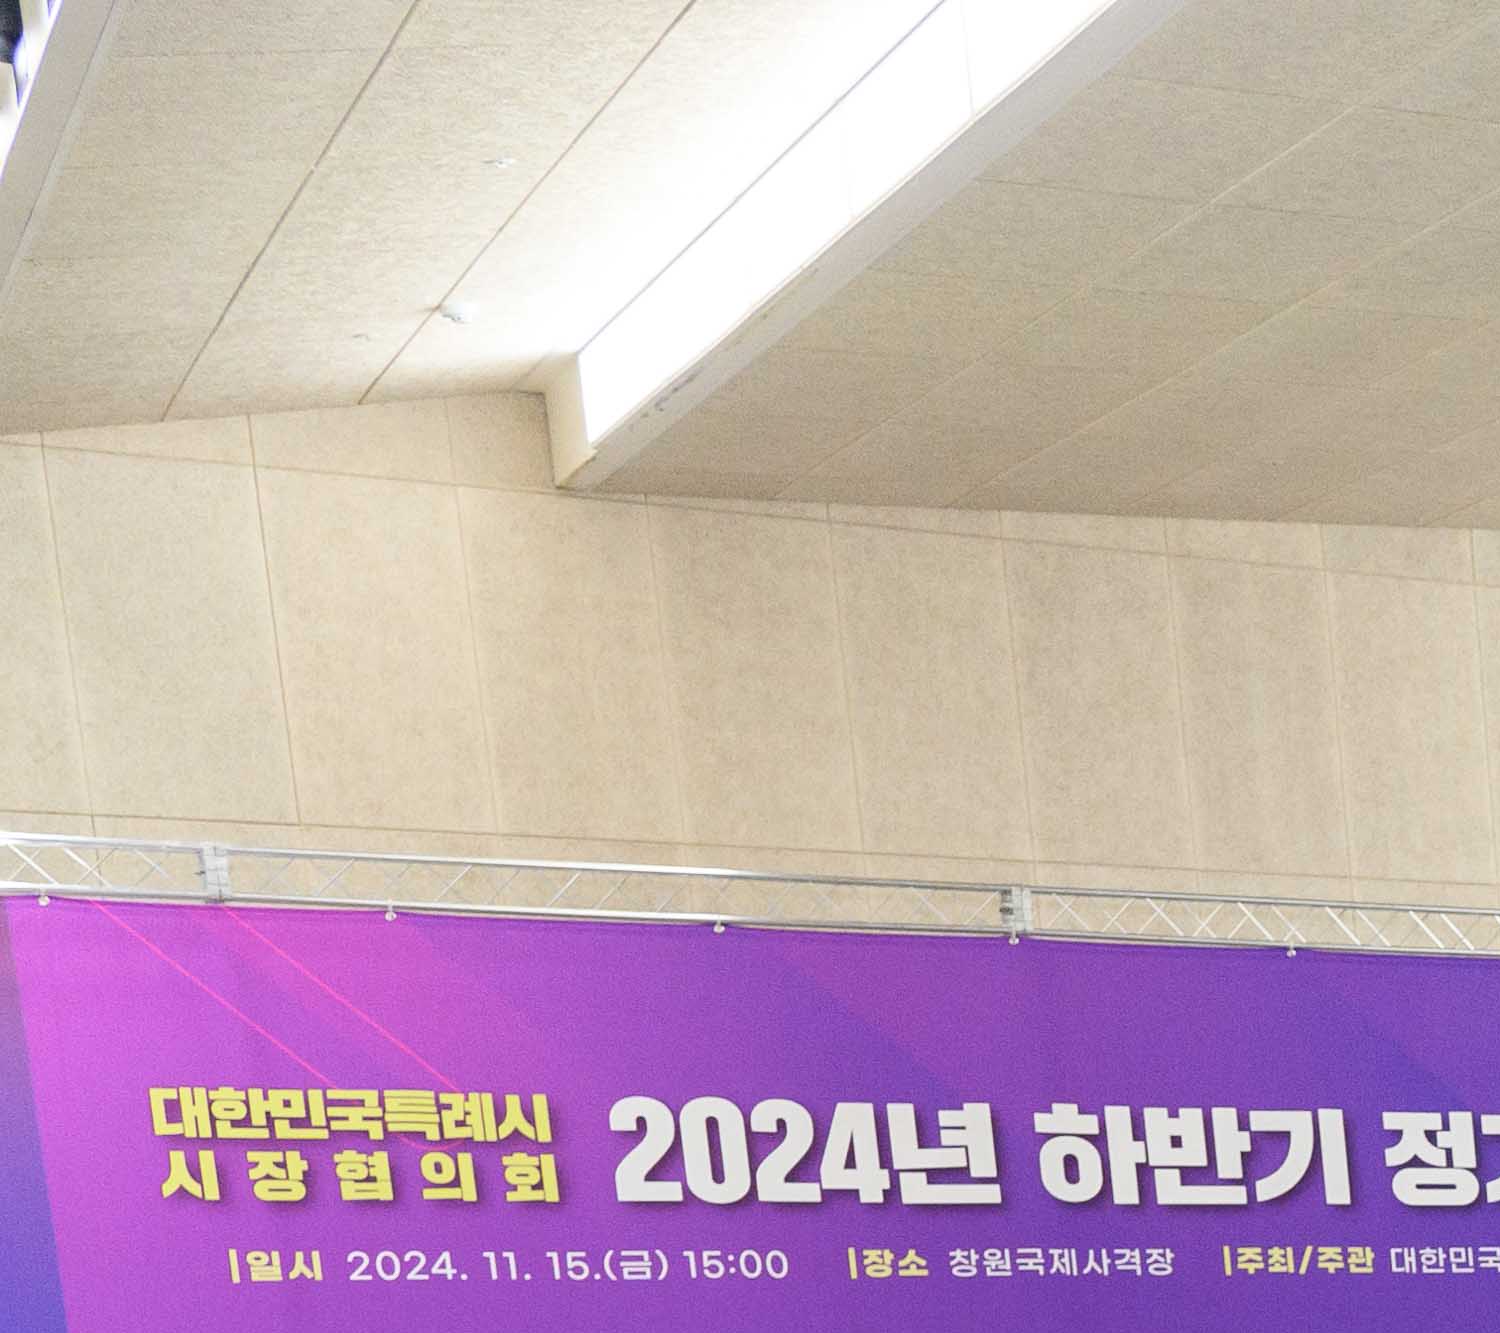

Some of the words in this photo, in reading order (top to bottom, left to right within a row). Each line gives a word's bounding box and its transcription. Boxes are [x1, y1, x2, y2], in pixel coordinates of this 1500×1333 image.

[148, 1086, 553, 1143] 대한민국특례시
[609, 1096, 1002, 1205] 2024년
[1032, 1102, 1352, 1206] 하반기
[346, 1250, 469, 1281] 2024.
[482, 1250, 532, 1281] 11.
[546, 1248, 669, 1283] 15.(금)
[682, 1249, 789, 1280] 15:00
[948, 1246, 1176, 1278] 창원국제사격장
